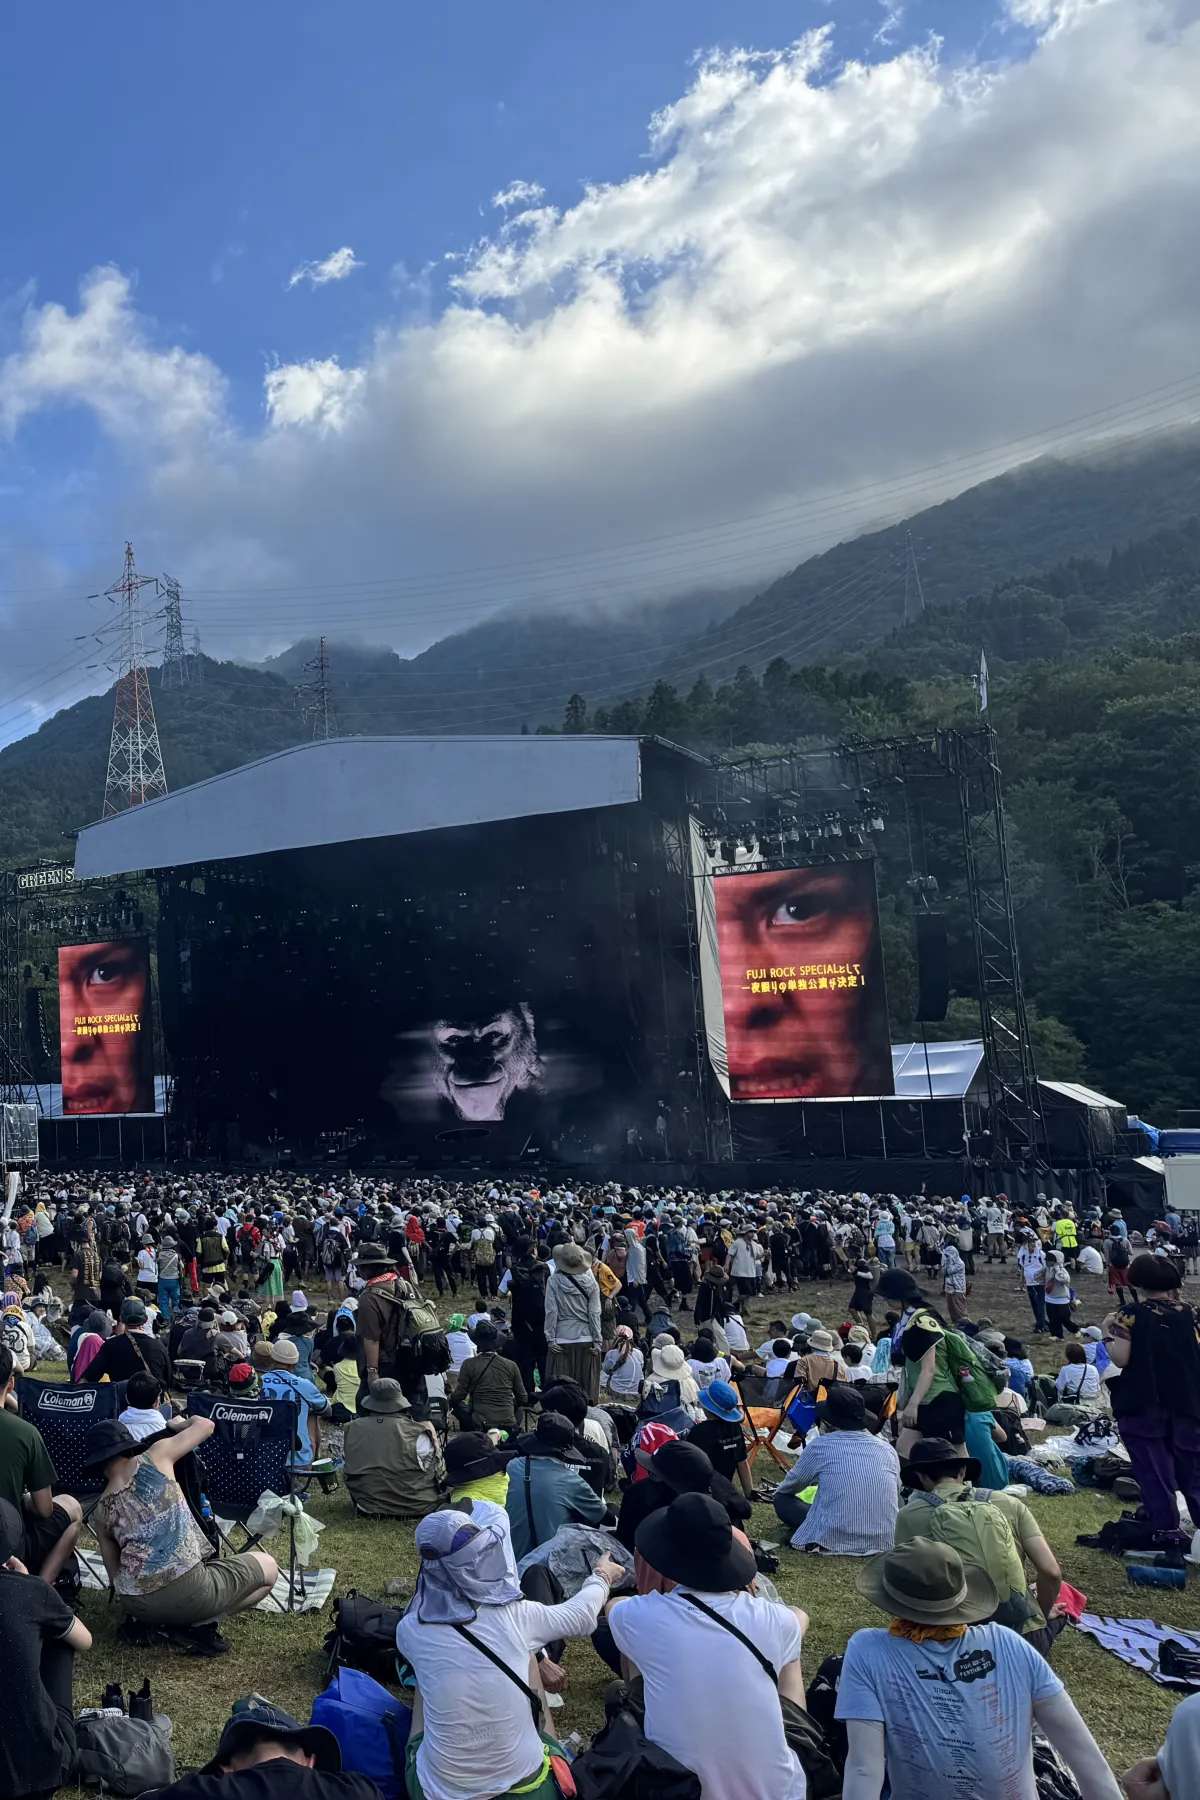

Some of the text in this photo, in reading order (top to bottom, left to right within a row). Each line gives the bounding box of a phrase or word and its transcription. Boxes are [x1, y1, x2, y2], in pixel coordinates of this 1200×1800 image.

[18, 869, 63, 889] GREEN
[746, 968, 766, 980] FUJI
[770, 966, 796, 979] ROCK
[74, 1016, 86, 1025] FUJI
[87, 1015, 103, 1024] ROCK
[43, 1391, 84, 1407] Coleman
[216, 1406, 258, 1422] Coleman
